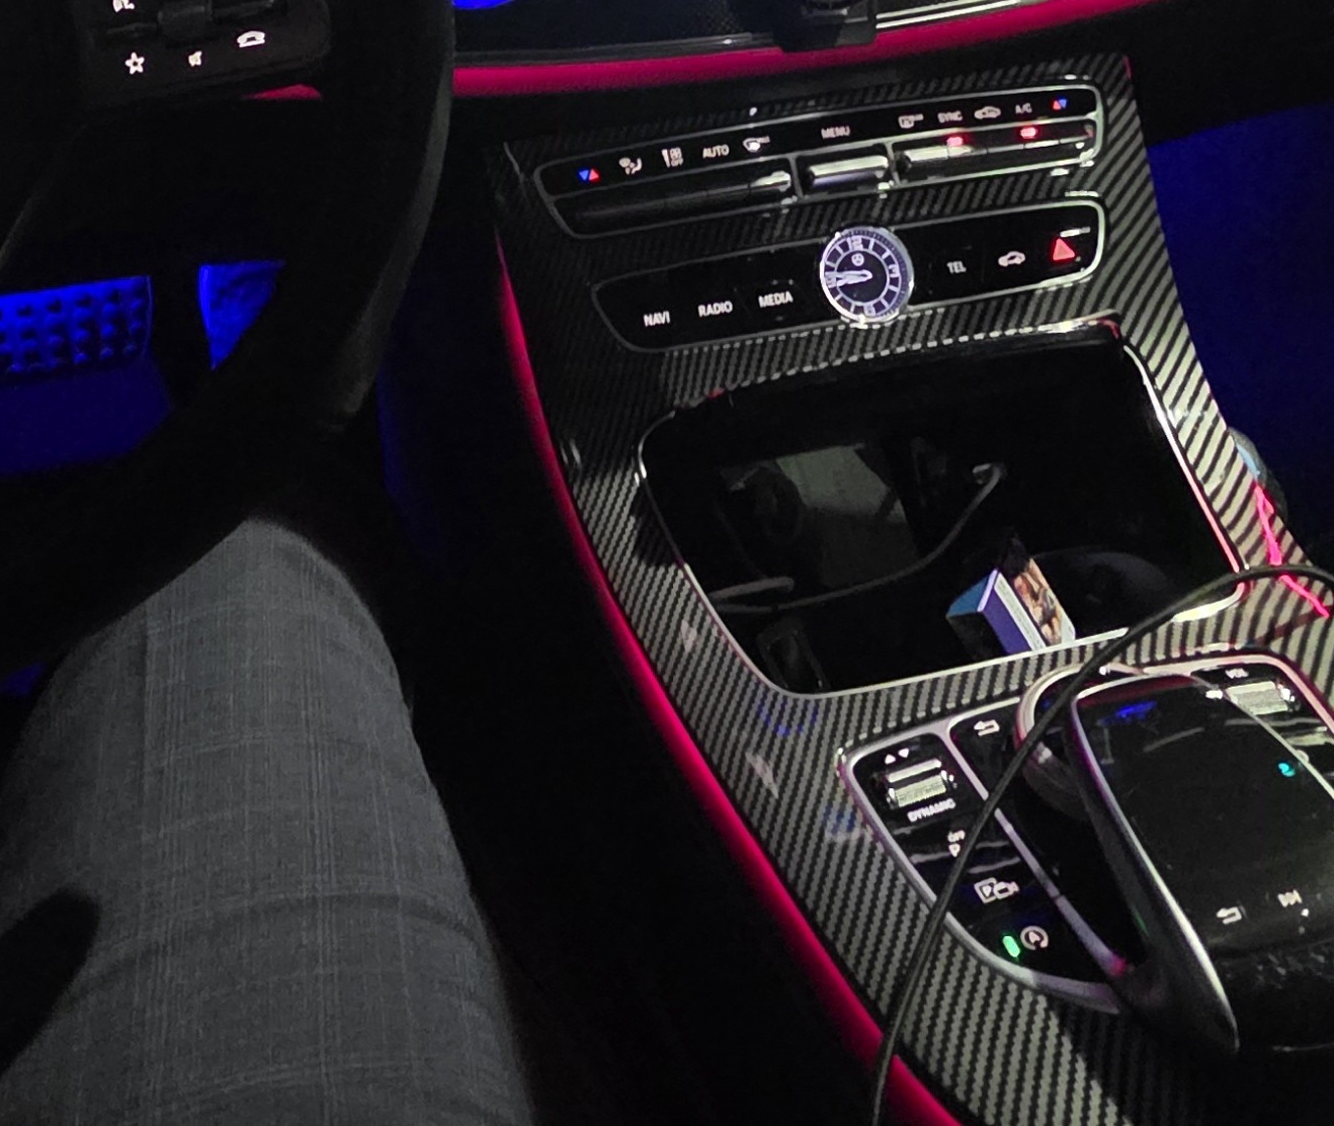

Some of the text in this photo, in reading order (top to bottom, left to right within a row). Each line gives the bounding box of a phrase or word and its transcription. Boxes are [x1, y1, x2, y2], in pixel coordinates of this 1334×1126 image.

[821, 125, 851, 139] MENU
[702, 144, 730, 159] AUTO
[947, 260, 967, 274] TEL
[758, 290, 793, 308] MEDIA
[698, 300, 732, 317] RADIO
[644, 311, 670, 327] NAVI
[907, 798, 956, 823] DYNAMIC
